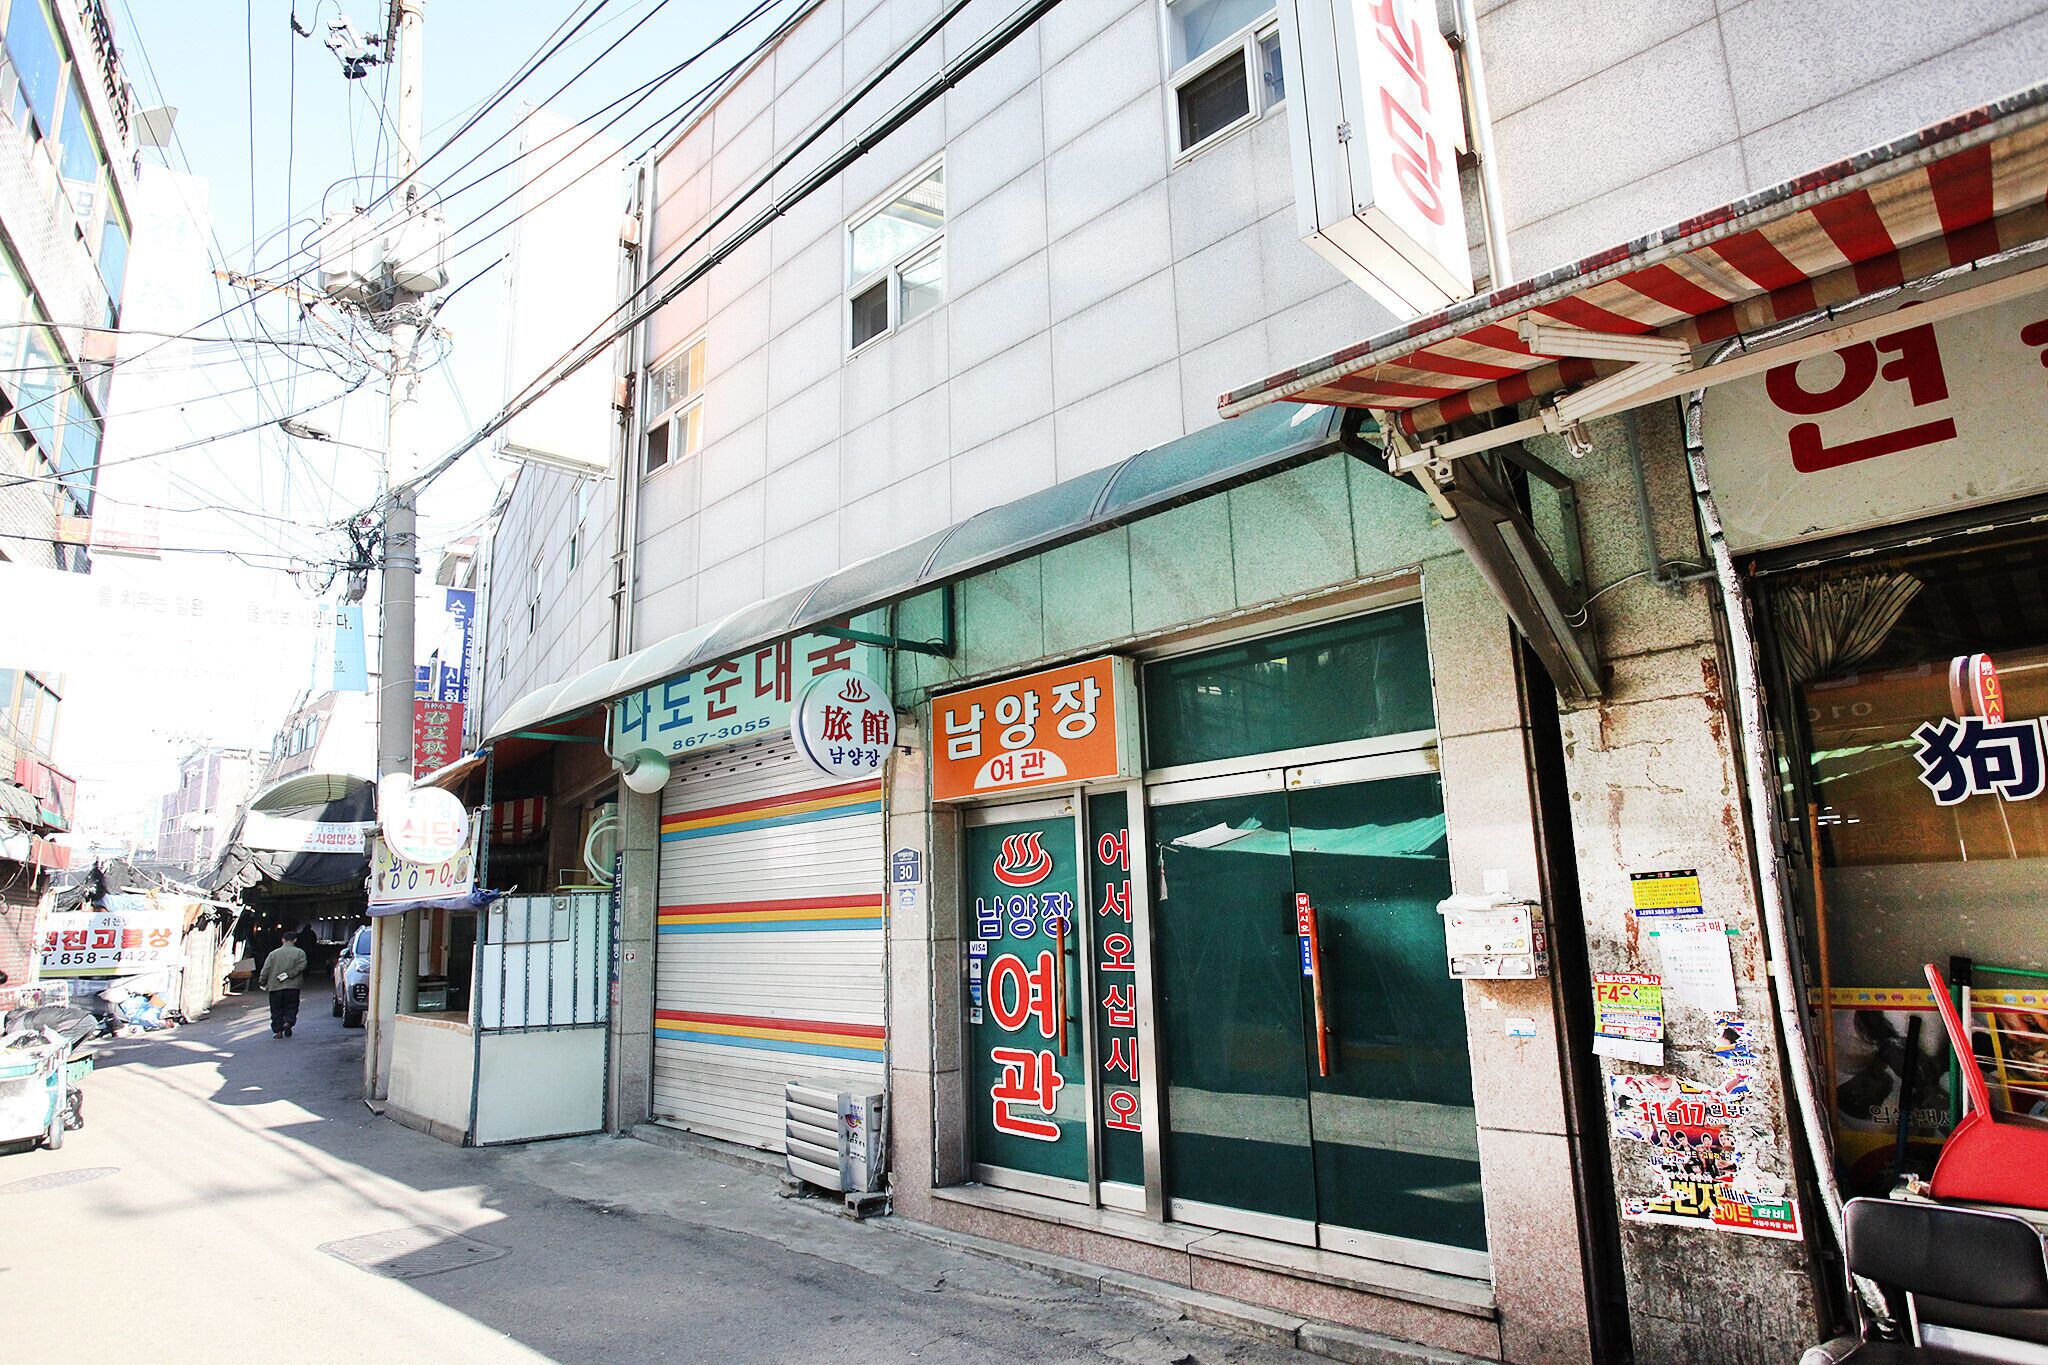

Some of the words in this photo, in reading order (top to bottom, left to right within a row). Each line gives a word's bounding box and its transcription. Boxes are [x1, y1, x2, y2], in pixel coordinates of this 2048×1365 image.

[672, 716, 771, 751] 867-3055
[820, 704, 891, 746] 旅館
[945, 676, 1102, 761] 남양장
[828, 746, 881, 768] 남양장
[990, 750, 1046, 783] 여관
[400, 818, 459, 847] 식당
[899, 864, 913, 881] 30
[976, 891, 1074, 940] 남양장
[41, 951, 160, 966] T.858-4422
[971, 943, 987, 952] VISA
[1097, 829, 1143, 1132] 어서오십시오
[1597, 984, 1620, 1002] F4
[987, 949, 1065, 1142] 여관
